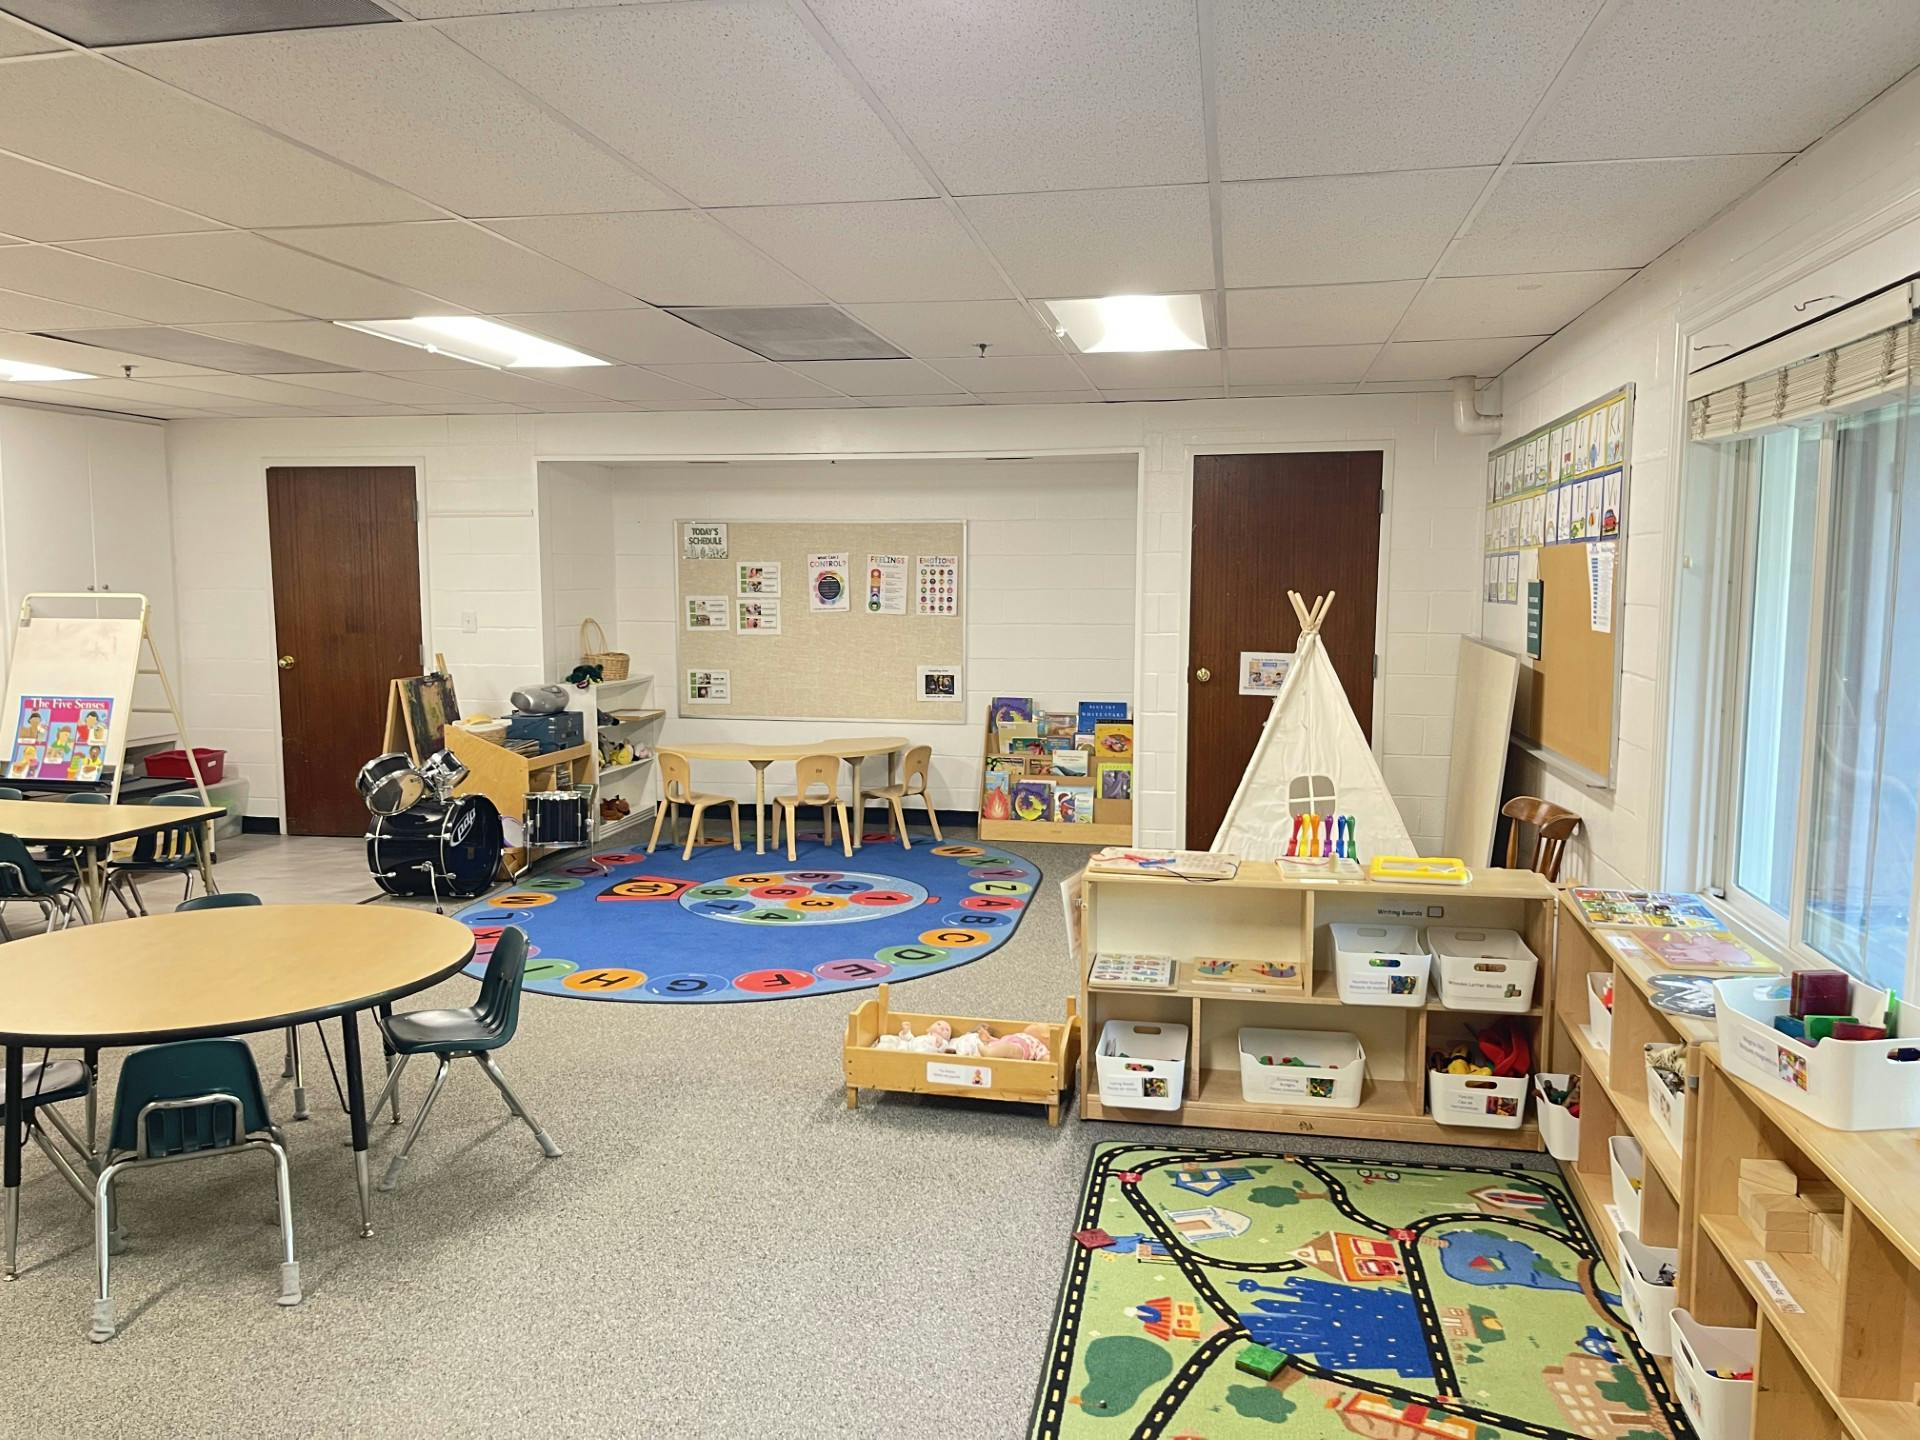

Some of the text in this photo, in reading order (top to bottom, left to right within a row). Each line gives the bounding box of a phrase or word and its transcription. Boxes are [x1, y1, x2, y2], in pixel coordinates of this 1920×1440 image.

[688, 537, 722, 545] SCHEDULE
[809, 560, 847, 568] CONTROL?
[870, 555, 905, 564] FEELINGS
[919, 556, 956, 564] EMOTIONS
[32, 698, 105, 709] The Five Senses
[457, 808, 476, 841] pdp
[800, 872, 830, 880] 5
[983, 870, 1015, 878] Y
[626, 883, 662, 893] 10
[985, 884, 1017, 892] Z
[801, 900, 834, 908] 3
[977, 899, 1012, 909] A
[476, 912, 514, 920] L
[754, 912, 789, 920] 4
[960, 914, 997, 925] B
[938, 932, 975, 943] C
[894, 948, 936, 960] D
[832, 963, 876, 977] E
[580, 972, 629, 988] H
[763, 973, 792, 988] F
[665, 978, 709, 993] G
